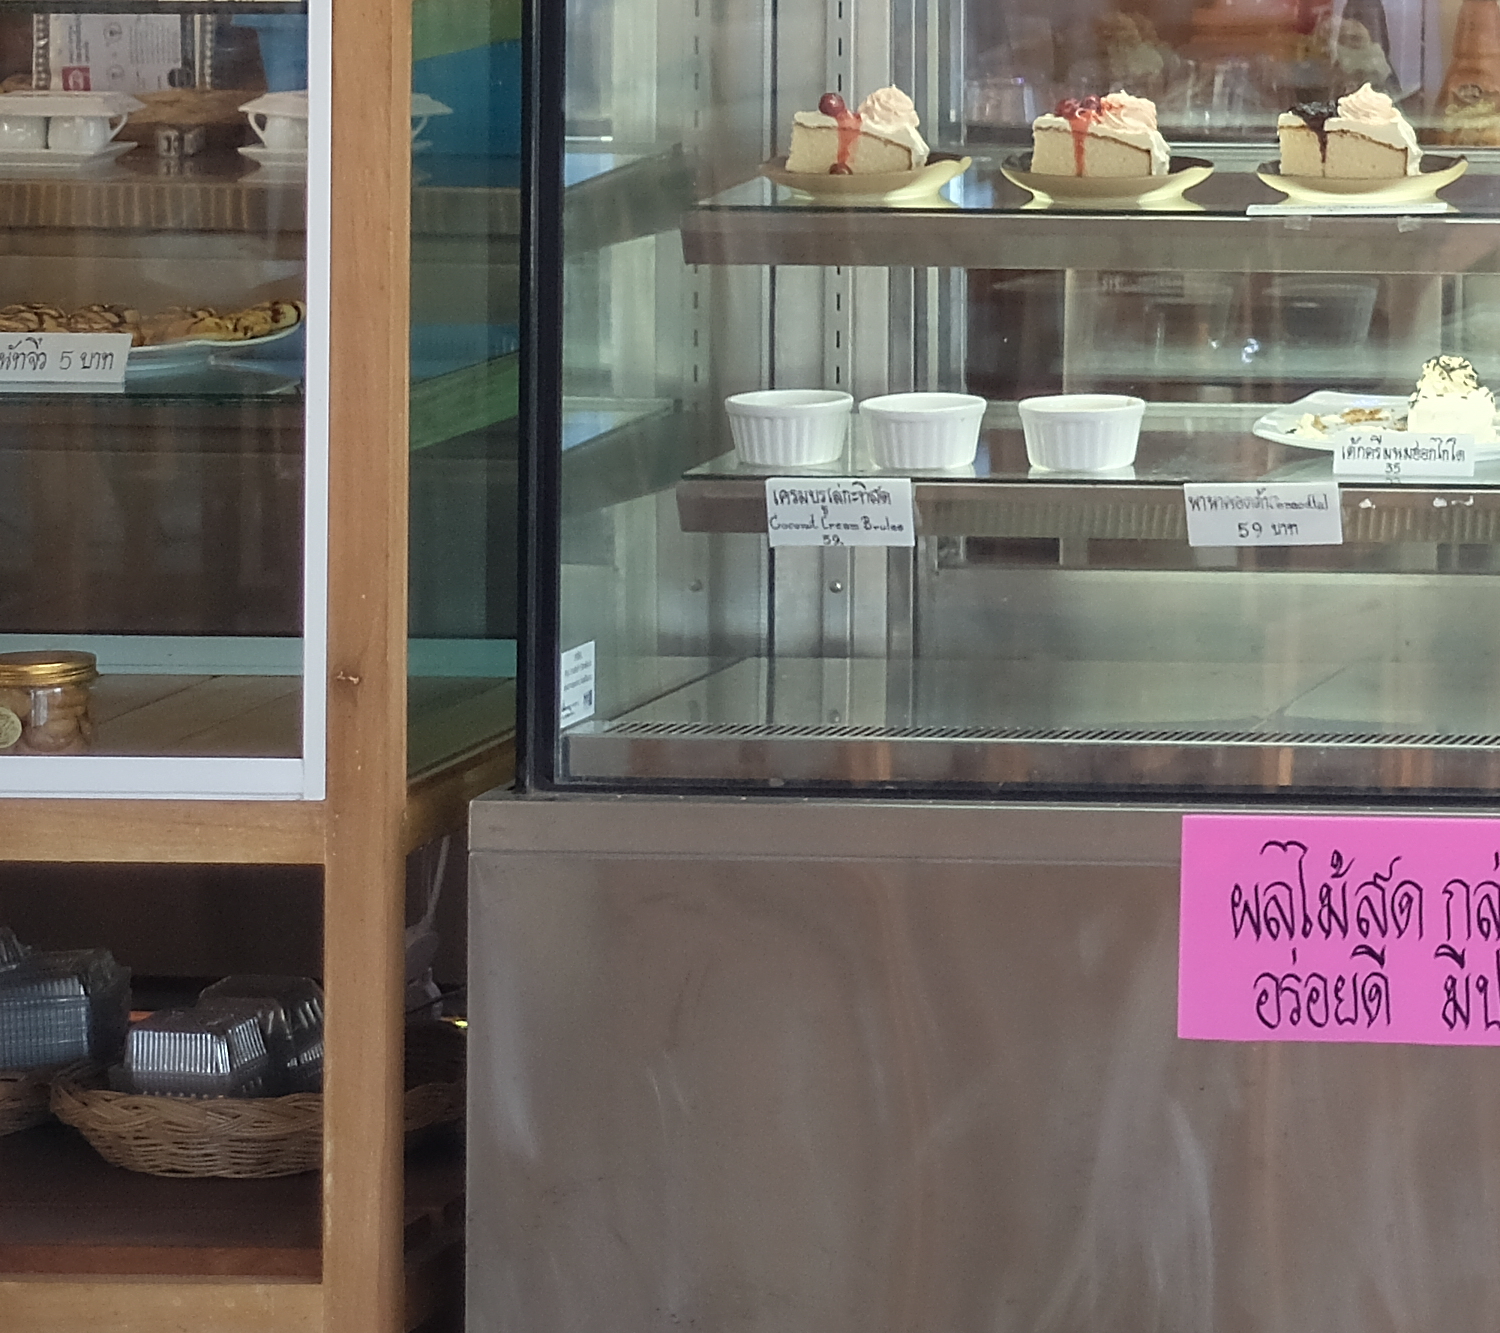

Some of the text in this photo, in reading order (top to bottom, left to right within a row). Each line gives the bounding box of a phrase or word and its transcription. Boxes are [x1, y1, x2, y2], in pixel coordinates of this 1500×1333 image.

[59, 350, 114, 370] 5 บาท
[1385, 463, 1401, 474] 35
[1237, 522, 1298, 538] 59 บาท
[1230, 840, 1425, 942] ผลไม้สด
[1254, 944, 1392, 1030] อร่อยดี
